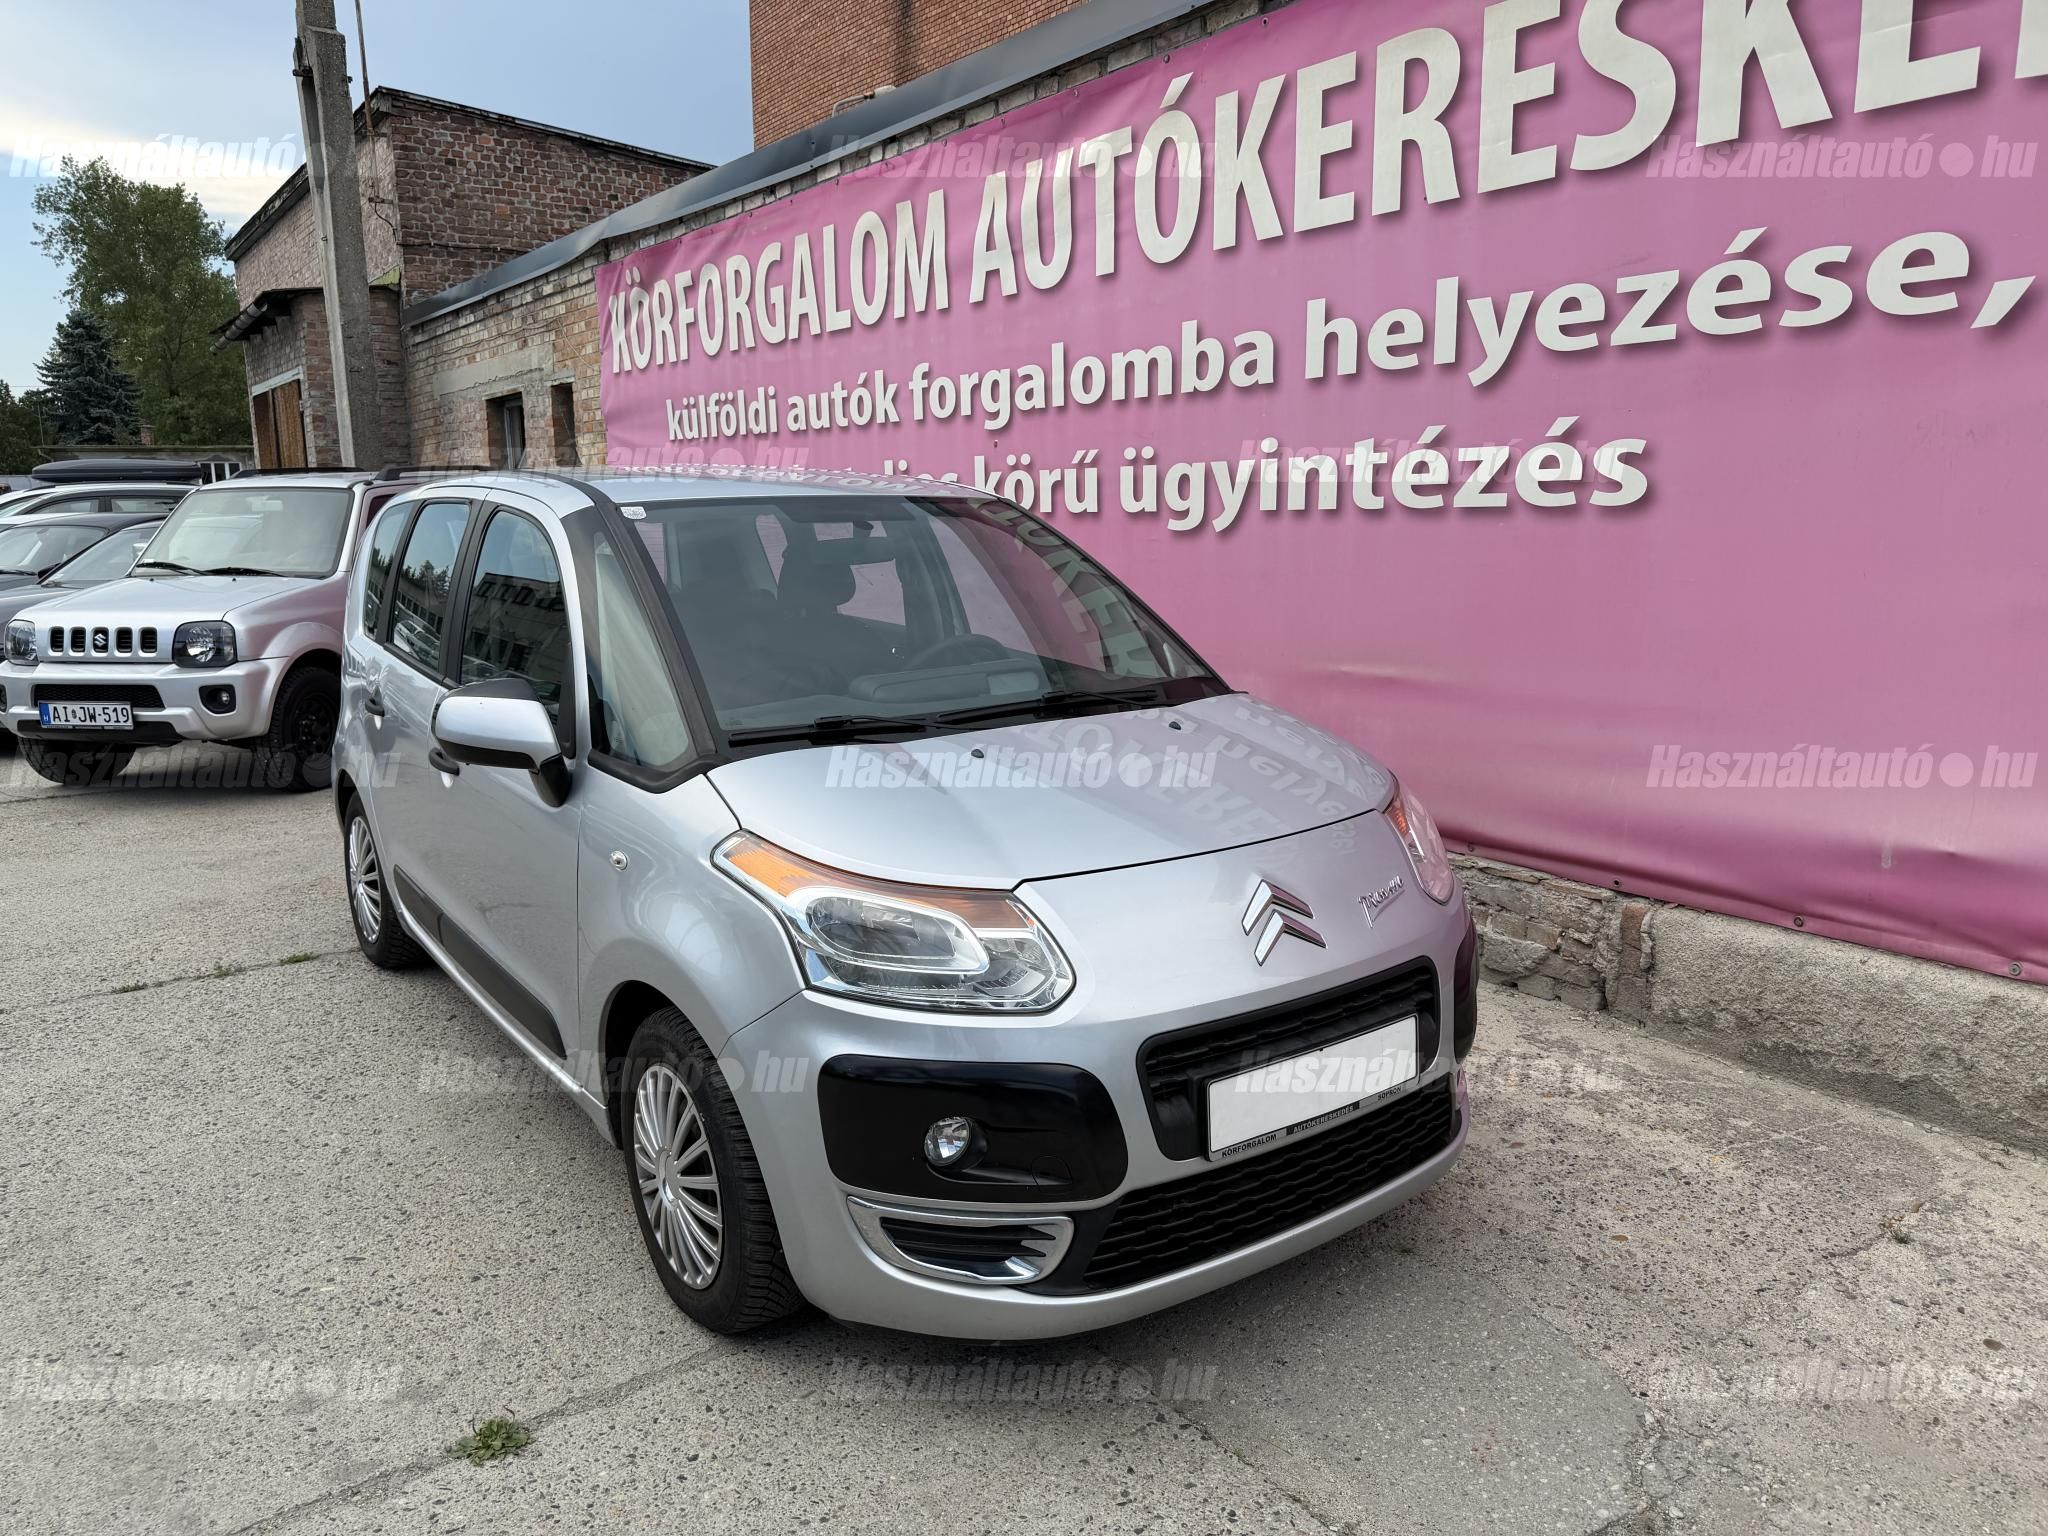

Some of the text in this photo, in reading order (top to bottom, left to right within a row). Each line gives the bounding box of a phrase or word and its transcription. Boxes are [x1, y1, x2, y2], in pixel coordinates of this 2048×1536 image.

[608, 0, 2048, 374] KÖRFORGALOM AUTÓKERESK
[667, 226, 2036, 441] külföldi autók forgalomba helyezése,
[974, 416, 1648, 532] körű ügyintézés
